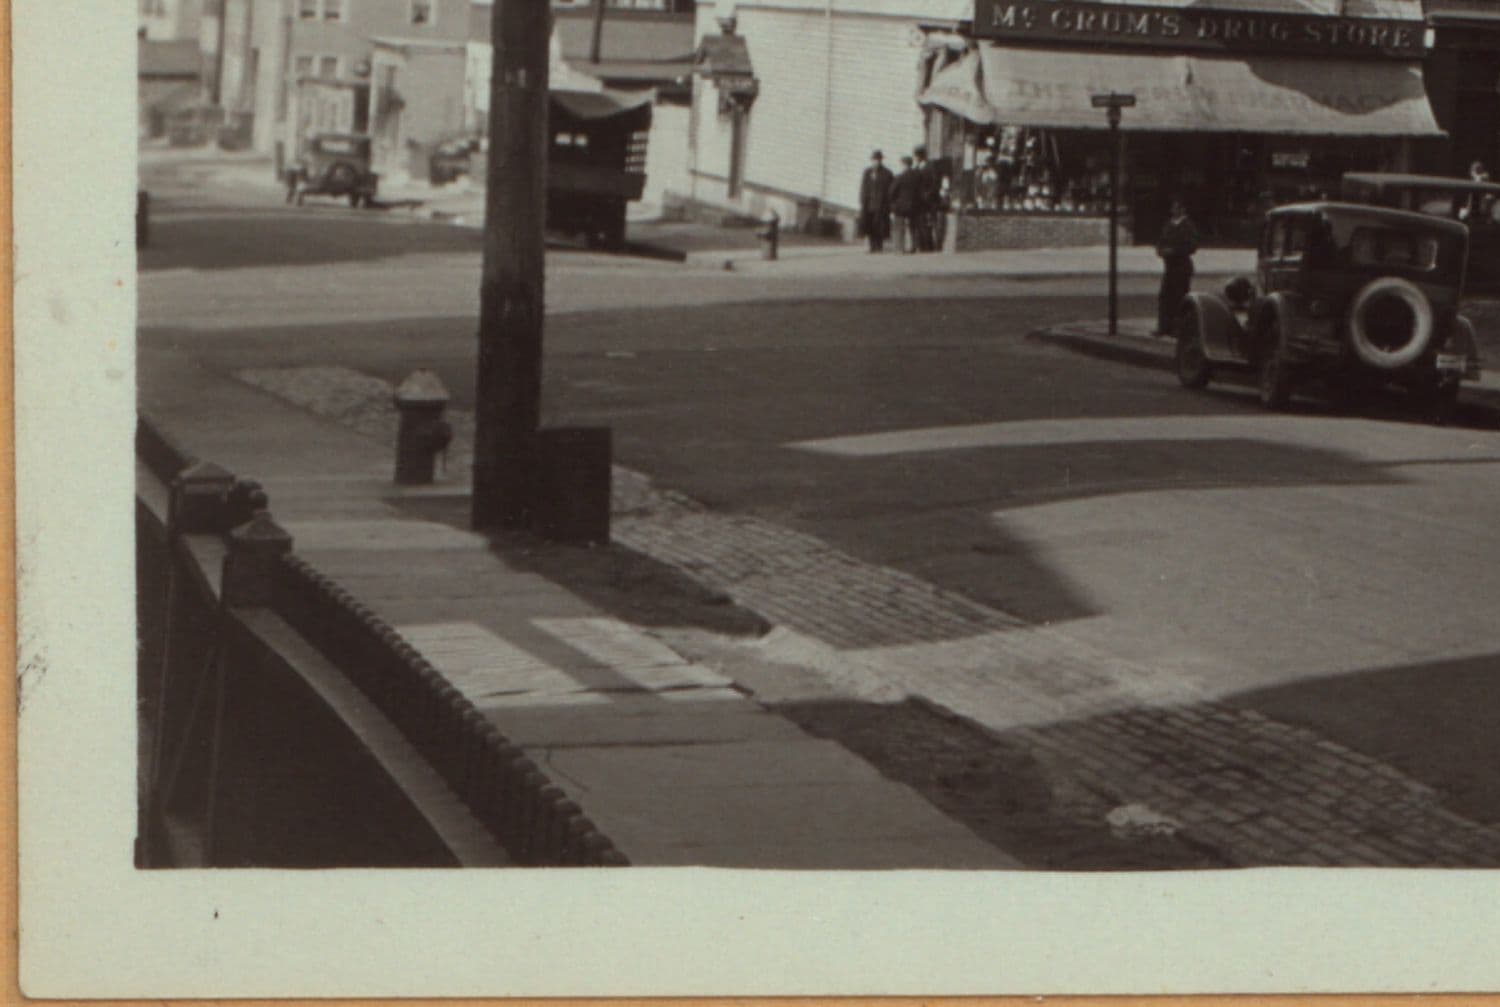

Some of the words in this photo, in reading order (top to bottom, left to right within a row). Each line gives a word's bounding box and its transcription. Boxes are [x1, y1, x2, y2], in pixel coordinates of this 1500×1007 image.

[1051, 6, 1180, 36] CRUM'S
[1196, 14, 1289, 40] DRUG
[1305, 21, 1411, 48] STORE
